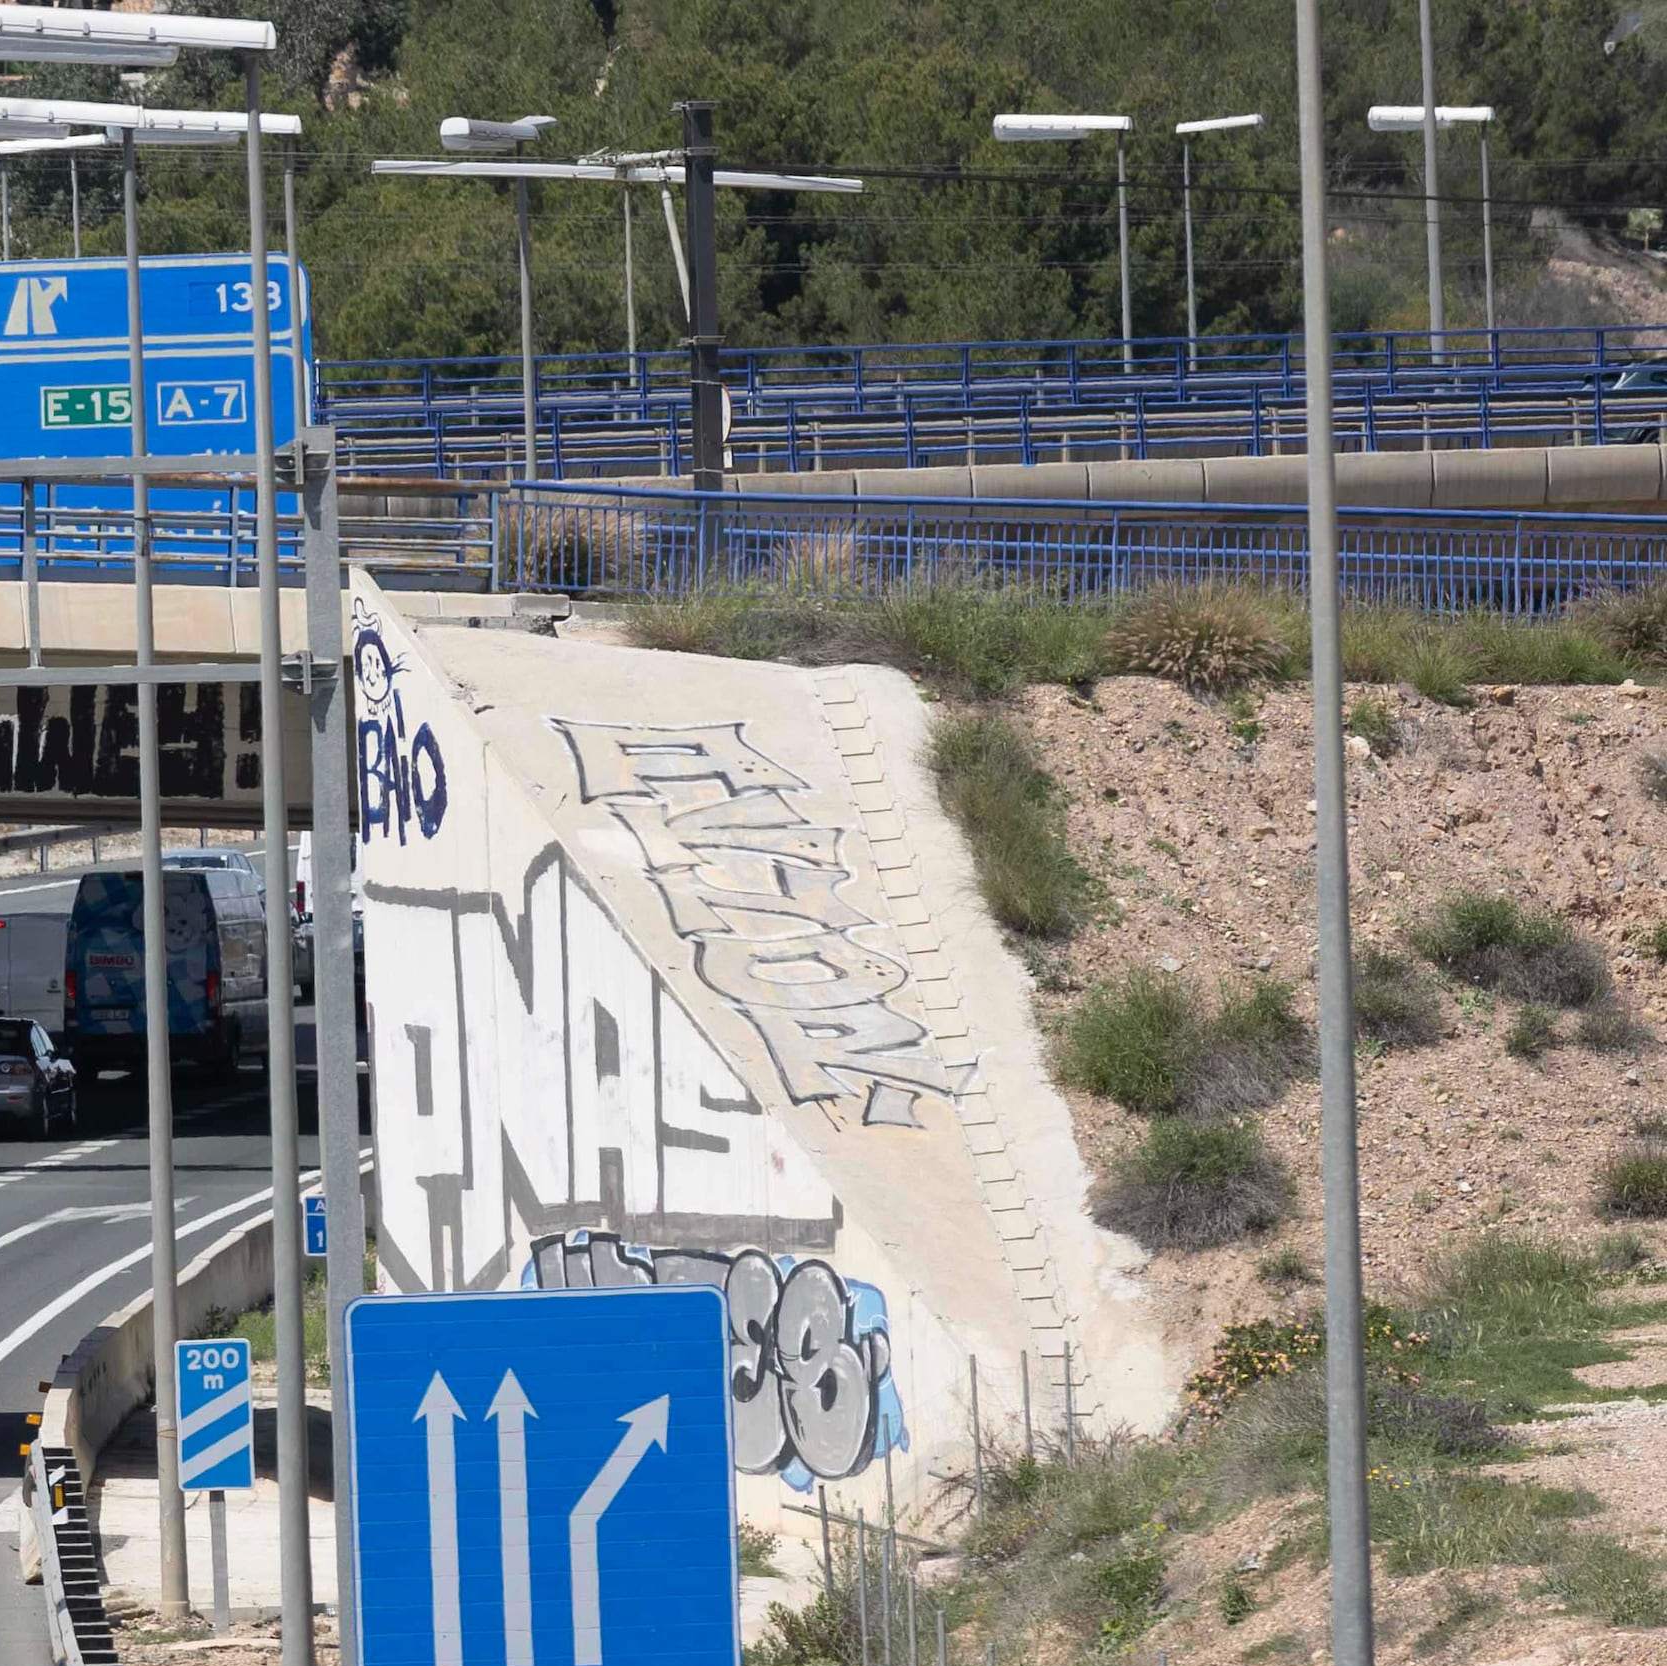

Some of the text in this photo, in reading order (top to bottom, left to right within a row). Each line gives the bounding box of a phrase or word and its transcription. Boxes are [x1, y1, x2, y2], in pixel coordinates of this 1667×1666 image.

[47, 391, 132, 423] E-15
[164, 386, 240, 419] A-7
[186, 1347, 240, 1371] 200
[203, 1373, 224, 1390] m
